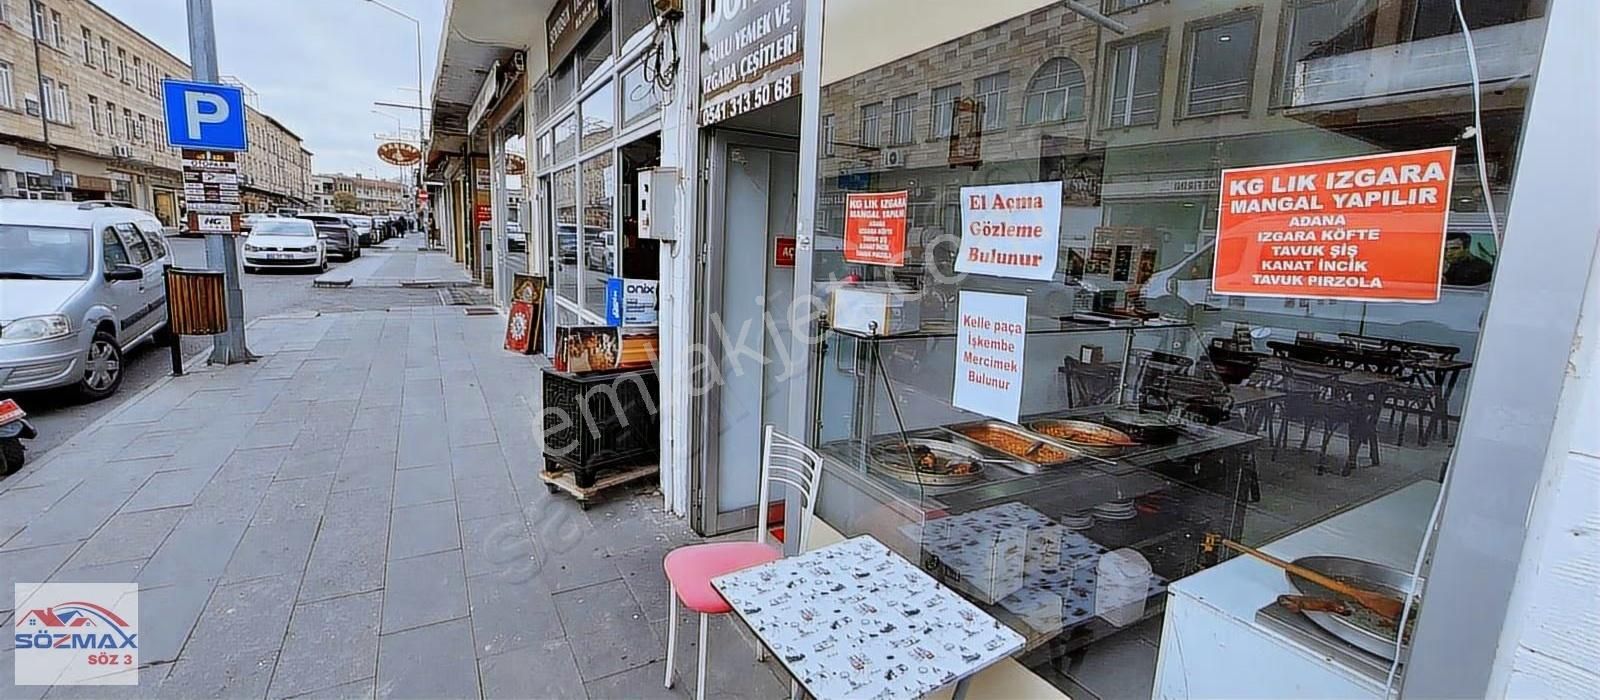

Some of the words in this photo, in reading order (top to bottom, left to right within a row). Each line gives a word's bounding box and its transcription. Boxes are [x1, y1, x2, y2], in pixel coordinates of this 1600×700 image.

[709, 35, 732, 65] SULU
[735, 11, 771, 50] YEMEK
[774, 1, 791, 28] VE
[703, 63, 737, 94] IZGARA
[740, 25, 798, 81] ÇEŞİTLERİ
[702, 102, 726, 126] 0541
[730, 92, 750, 117] 313
[754, 84, 770, 108] 50
[774, 75, 792, 101] 68
[184, 90, 230, 140] P
[1230, 177, 1264, 196] KG
[1272, 173, 1317, 193] LIK
[1326, 161, 1446, 190] IZGARA
[969, 194, 986, 210] El
[992, 193, 1043, 213] Açma
[1231, 196, 1324, 214] MANGAL
[1332, 187, 1438, 209] YAPILIR
[969, 220, 1043, 238] Gözleme
[1289, 214, 1346, 227] ADANA
[1257, 231, 1316, 243] IZGARA
[1321, 228, 1381, 241] KÖFTE
[967, 246, 1043, 267] Bulunur
[1271, 245, 1325, 257] TAVUK
[1330, 244, 1359, 260] ŞİŞ
[1262, 260, 1314, 271] KANAT
[1319, 257, 1368, 272] İNCİK
[626, 283, 654, 294] onix
[1252, 274, 1304, 286] TAVUK
[1308, 275, 1383, 289] PIRZOLA
[963, 314, 991, 330] Kelle
[994, 321, 1022, 335] paça
[968, 331, 1015, 352] İşkembe
[963, 351, 1018, 373] Mercimek
[968, 370, 1011, 391] Bulunur
